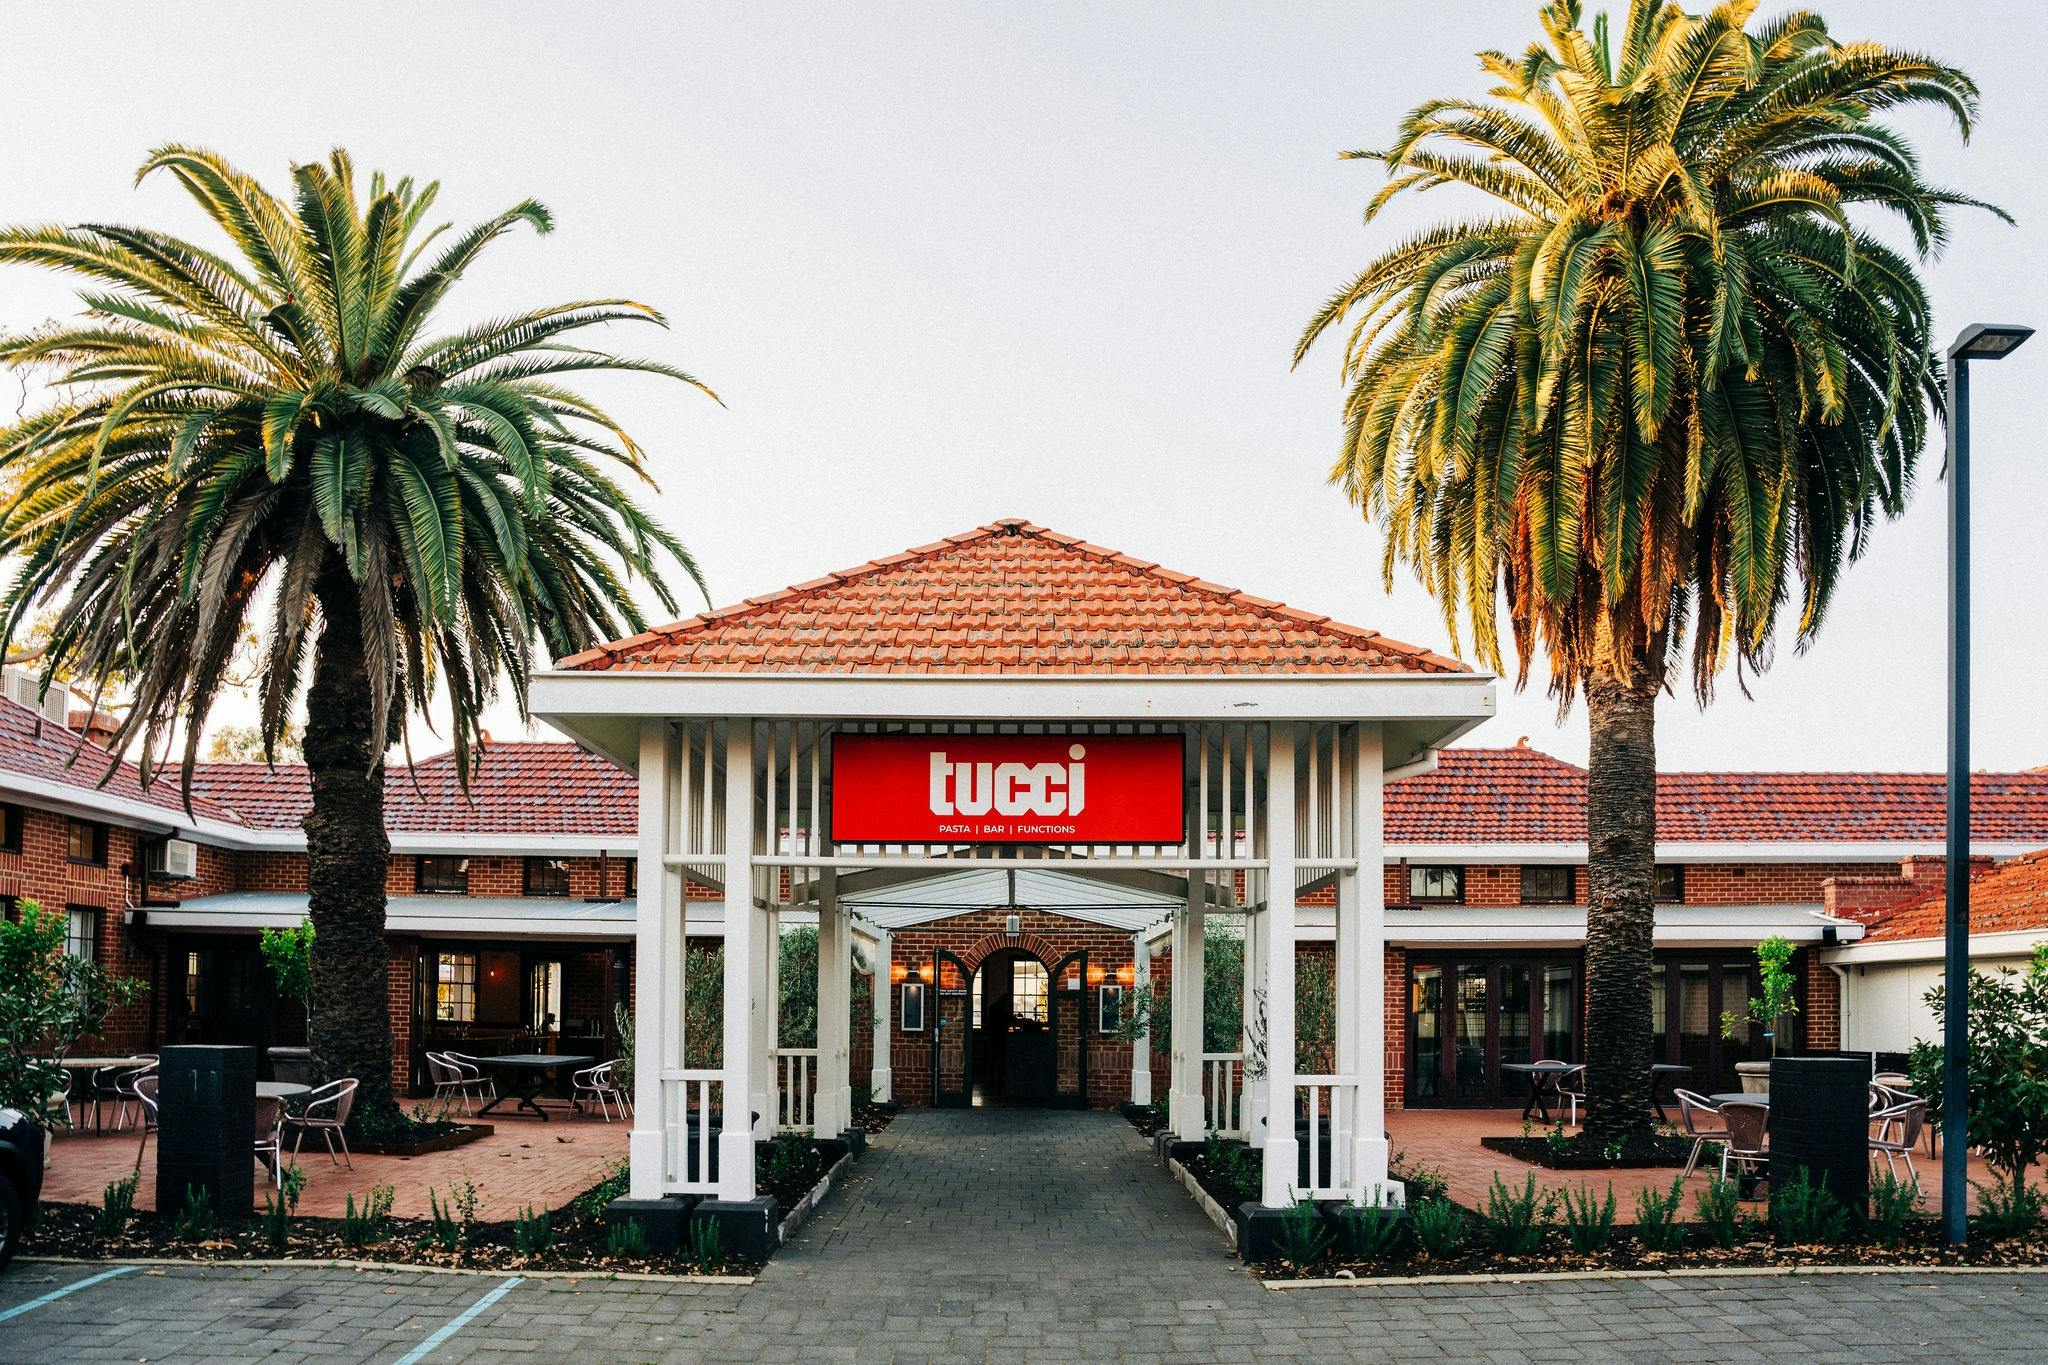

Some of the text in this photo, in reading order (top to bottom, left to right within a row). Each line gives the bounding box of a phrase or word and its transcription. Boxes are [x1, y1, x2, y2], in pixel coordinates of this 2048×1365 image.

[929, 743, 1086, 817] tucci
[939, 825, 1076, 833] PASTA BAR FUNCTIONS
